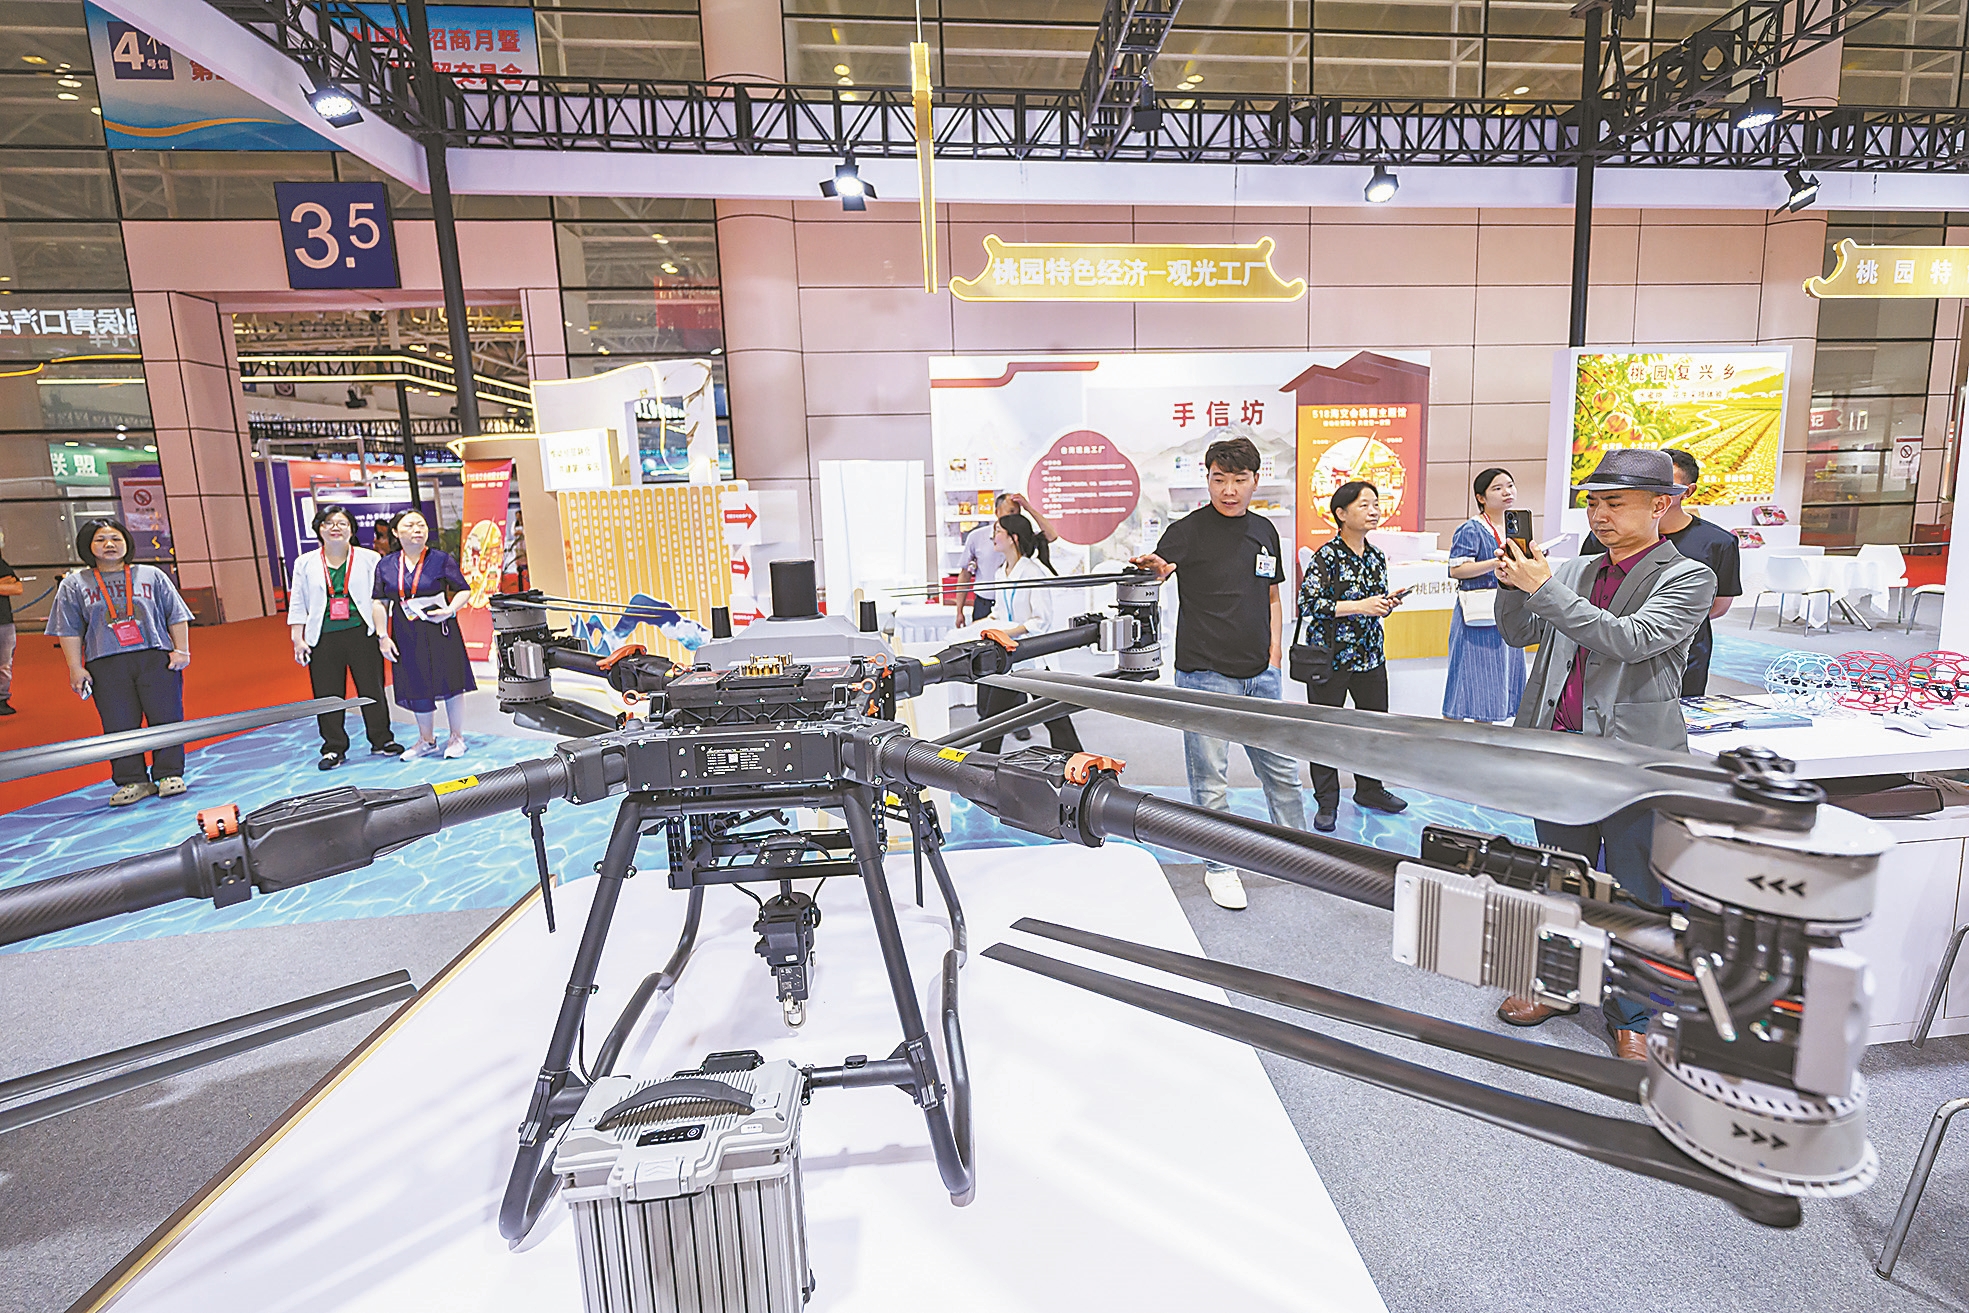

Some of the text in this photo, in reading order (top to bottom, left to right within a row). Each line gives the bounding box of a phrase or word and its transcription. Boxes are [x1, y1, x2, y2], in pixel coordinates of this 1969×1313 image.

[291, 202, 380, 269] 3.5
[1856, 259, 1969, 285] 桃园特
[1629, 364, 1735, 381] 桃园复兴乡
[1172, 400, 1264, 427] 手信坊
[1415, 581, 1459, 595] 桃园特
